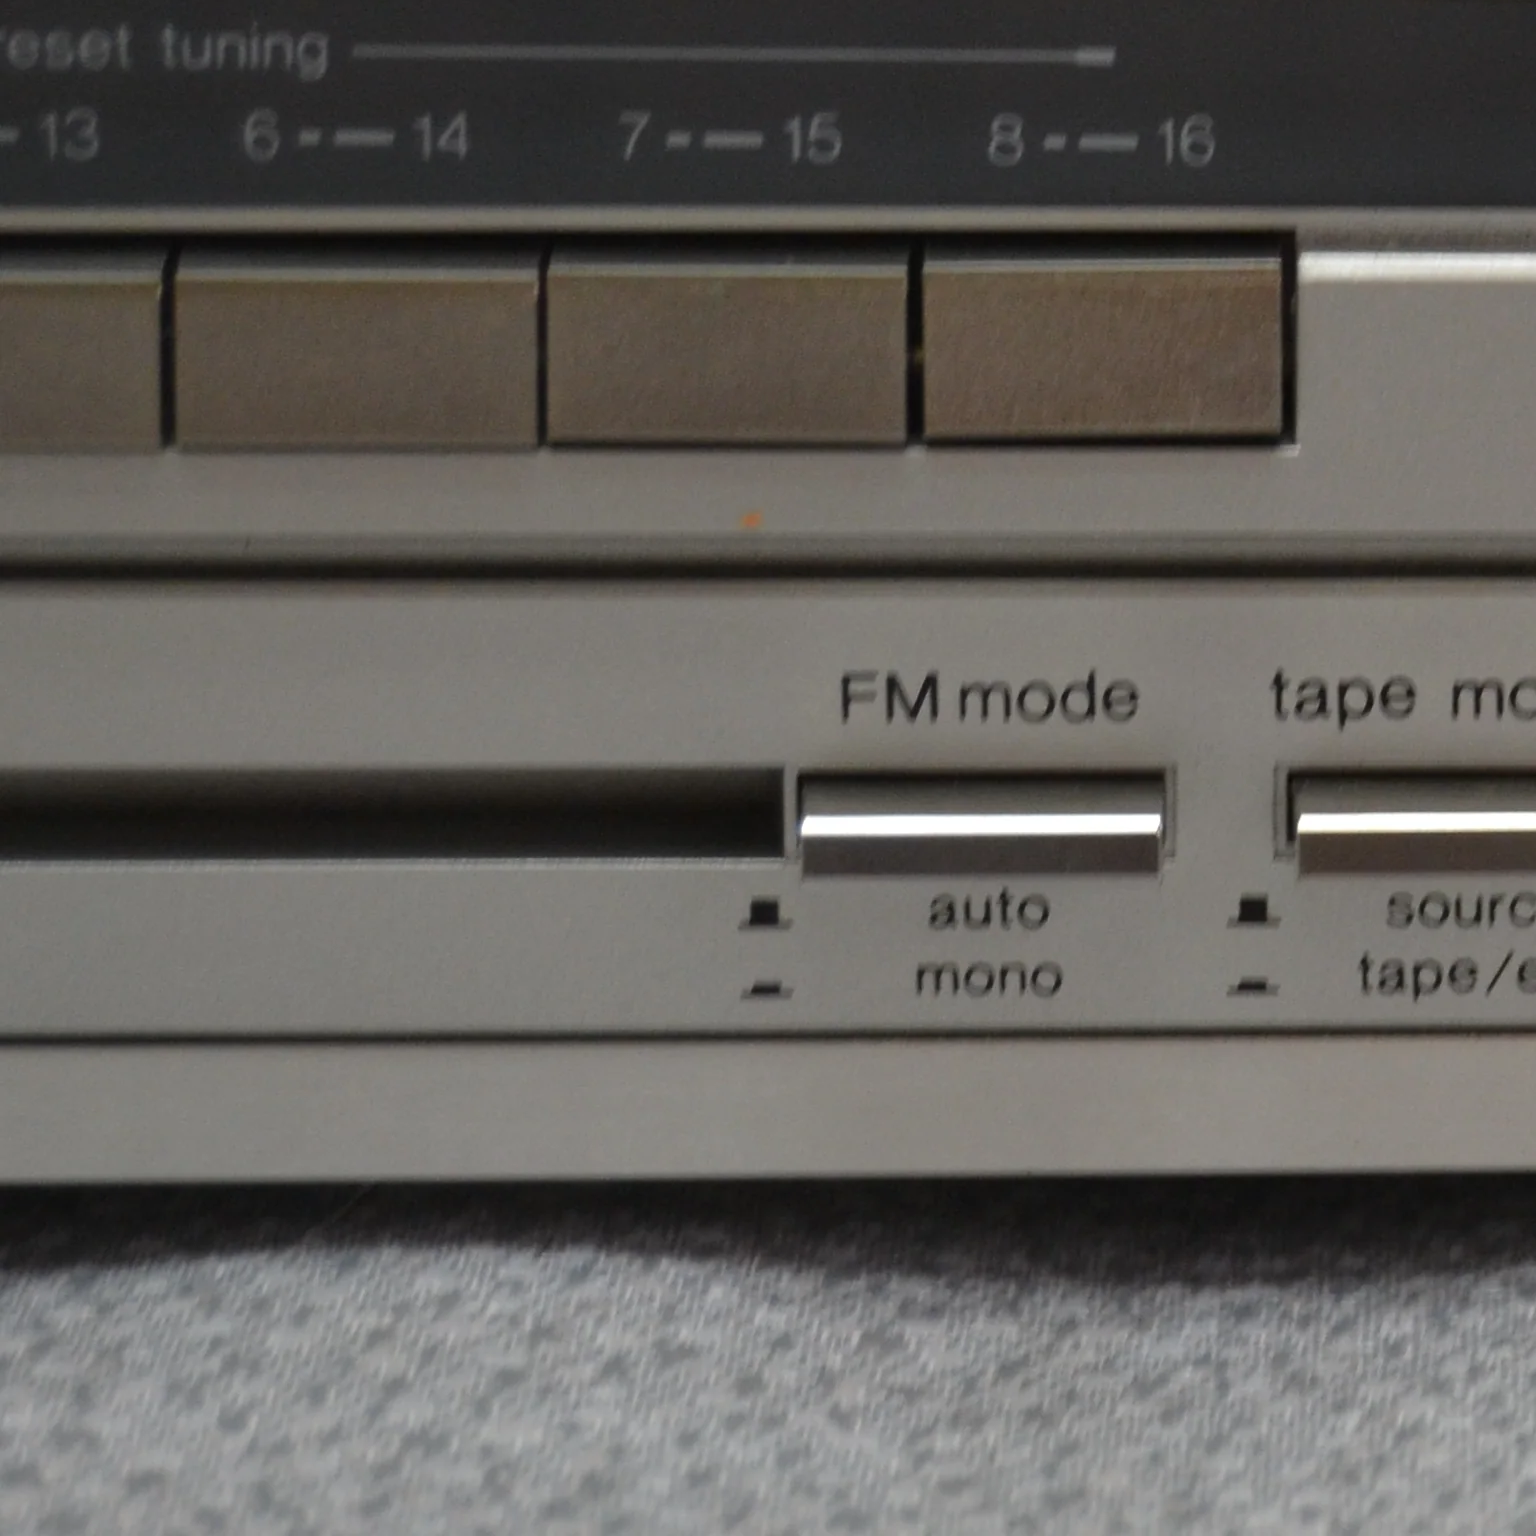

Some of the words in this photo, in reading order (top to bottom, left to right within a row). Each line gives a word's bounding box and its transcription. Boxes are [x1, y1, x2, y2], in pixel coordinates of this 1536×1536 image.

[0, 21, 132, 71] eset
[160, 23, 331, 83] tuning
[40, 107, 102, 163] 13
[242, 109, 282, 163] 6
[414, 111, 471, 162] 14
[620, 111, 653, 163] 7
[785, 112, 845, 166] 15
[987, 113, 1027, 168] 8
[1158, 114, 1218, 169] 16
[840, 671, 941, 726] FM
[958, 669, 1142, 726] mode
[1270, 669, 1419, 733] tape
[929, 887, 1052, 931] auto
[915, 962, 1065, 999] mono
